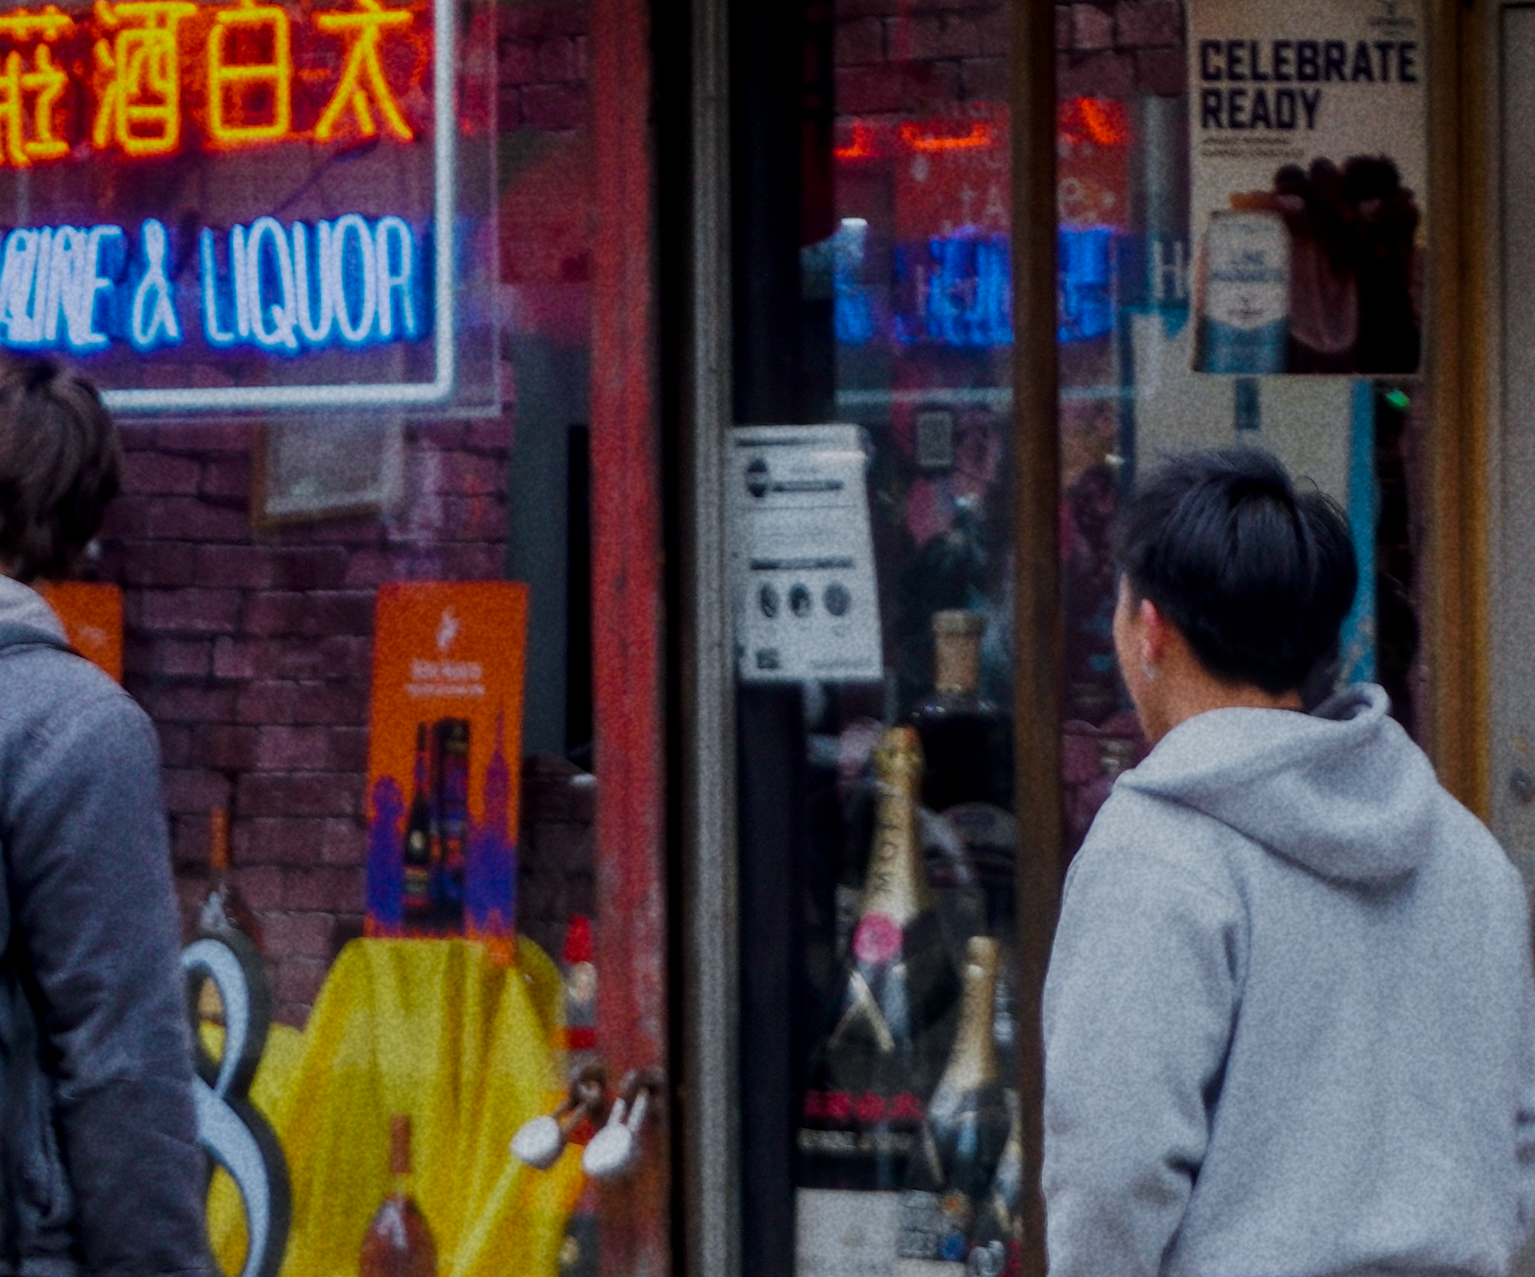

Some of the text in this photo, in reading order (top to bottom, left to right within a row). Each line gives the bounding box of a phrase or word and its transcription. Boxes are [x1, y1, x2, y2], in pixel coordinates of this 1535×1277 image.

[1200, 38, 1419, 85] CELEBRATE
[1200, 87, 1324, 131] READY
[131, 218, 180, 346] &
[201, 213, 419, 352] LIQUOR
